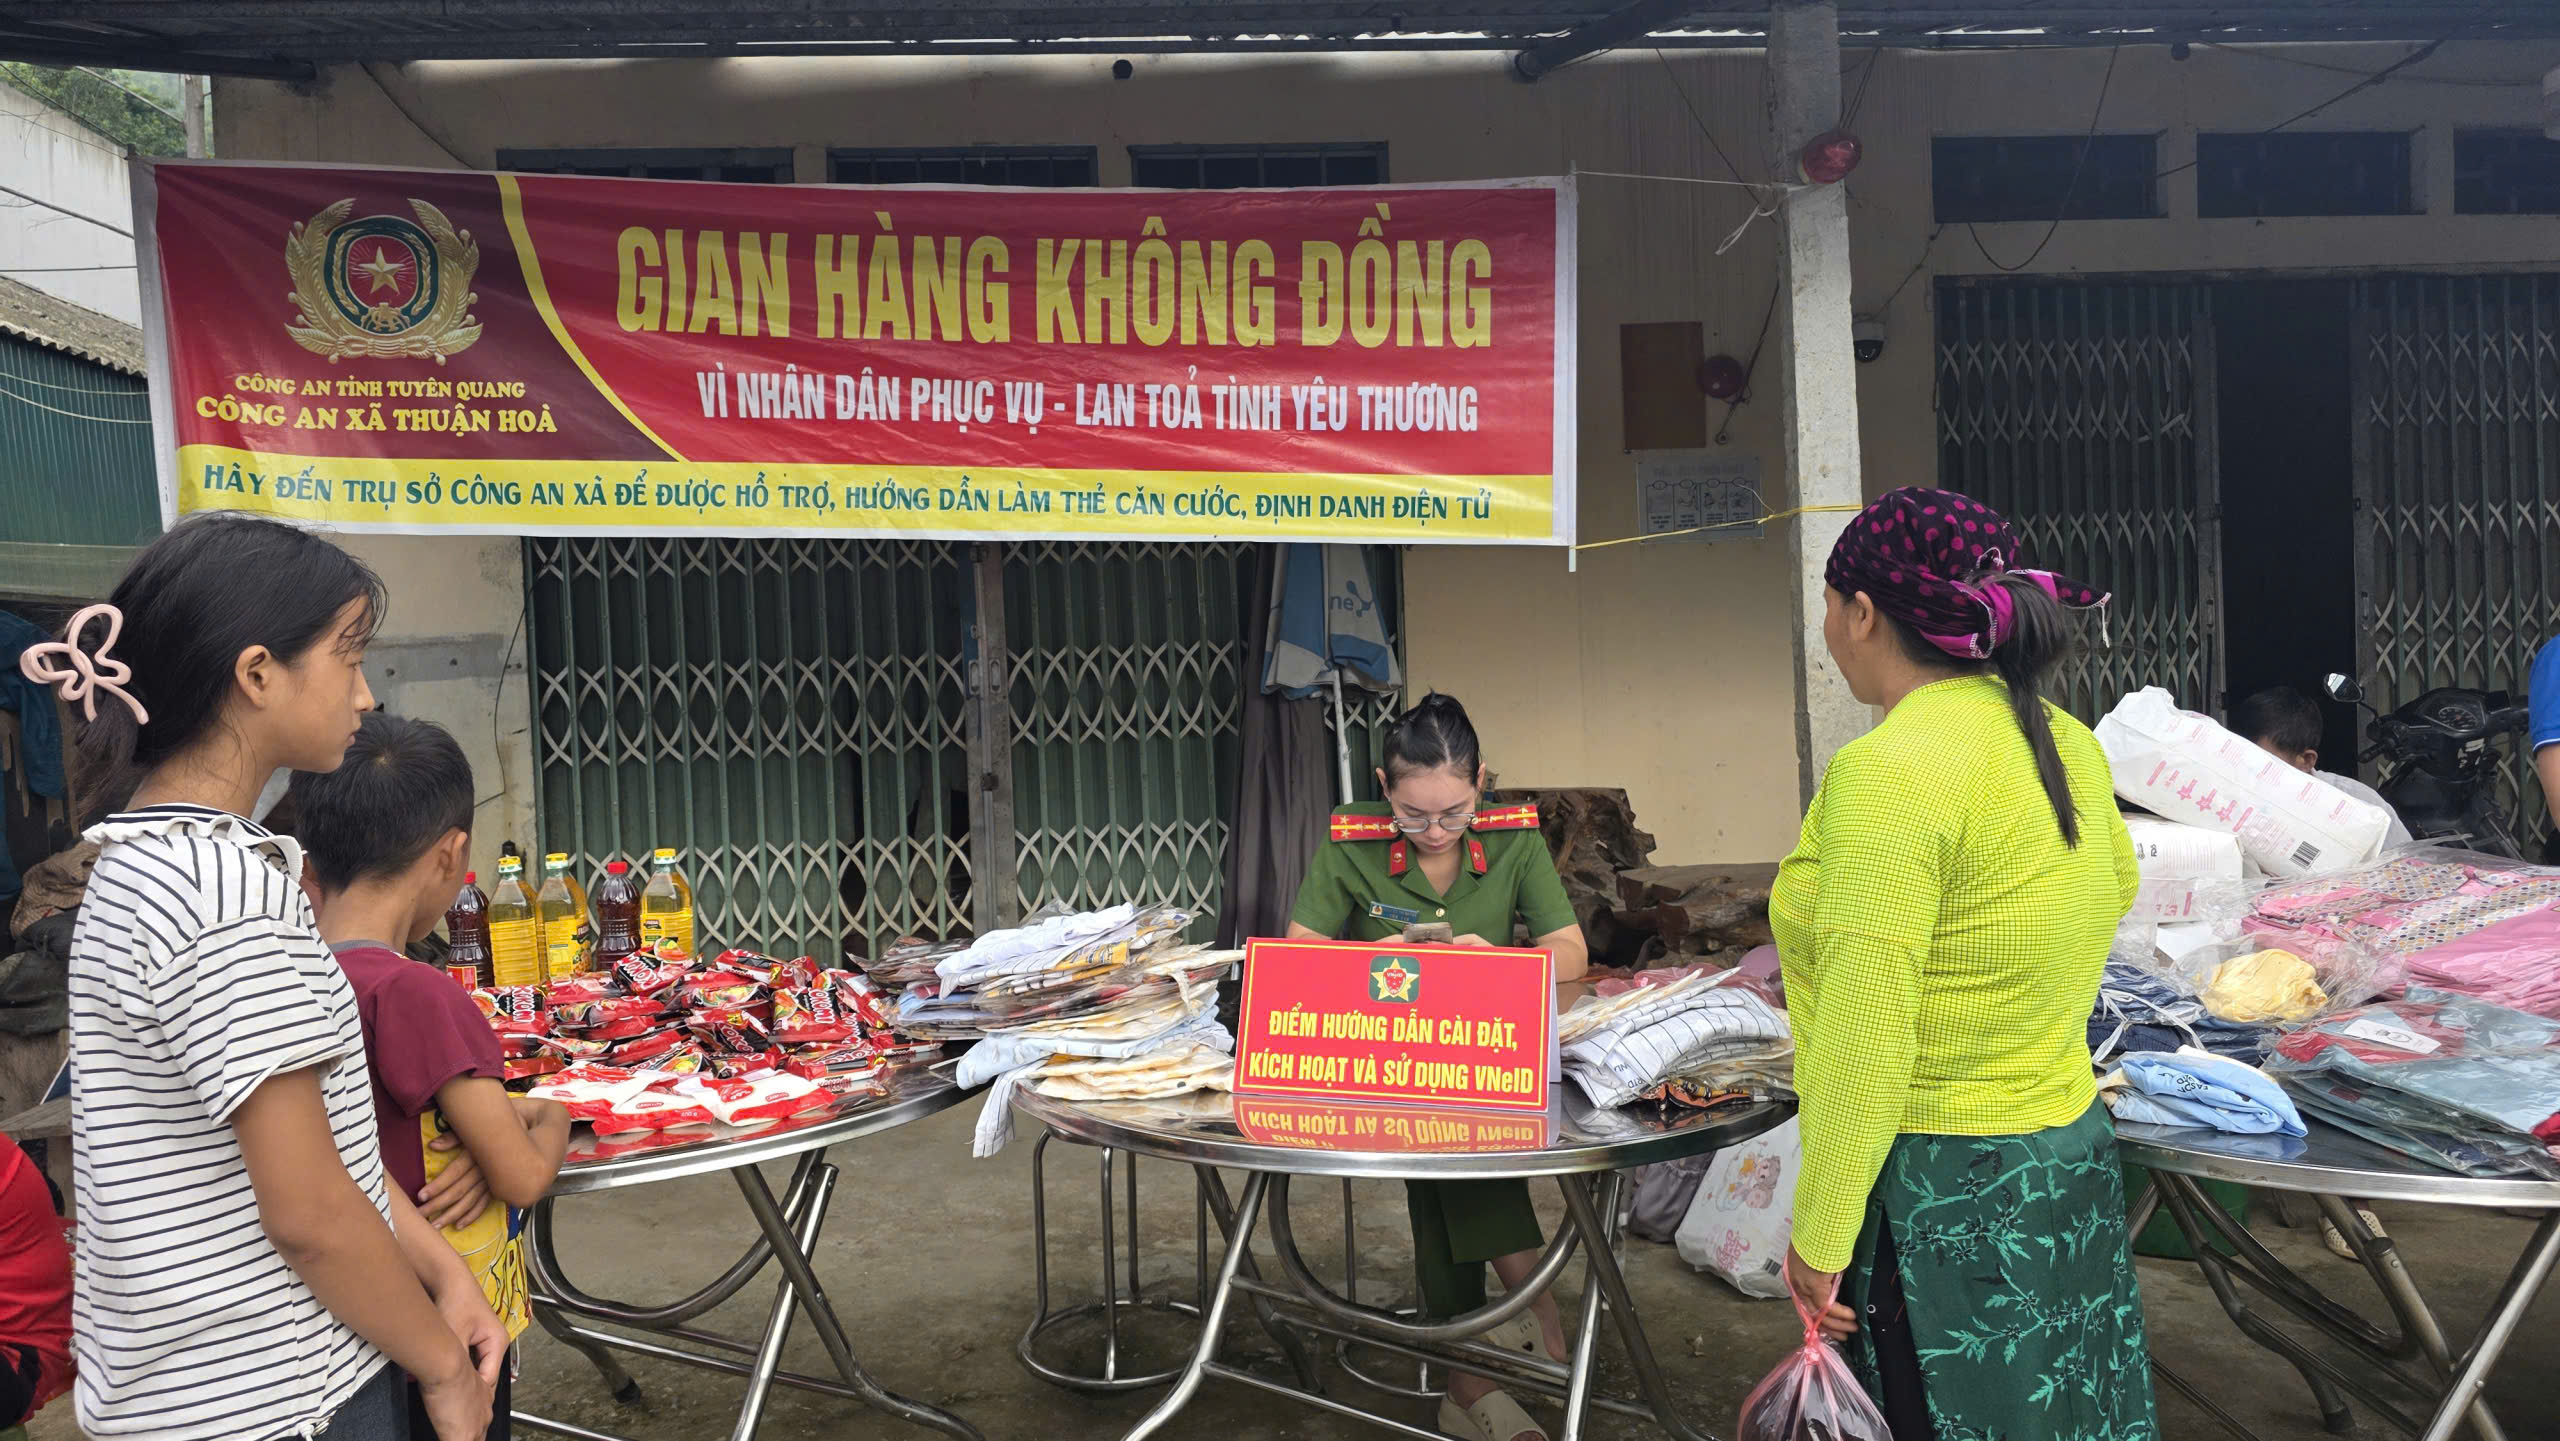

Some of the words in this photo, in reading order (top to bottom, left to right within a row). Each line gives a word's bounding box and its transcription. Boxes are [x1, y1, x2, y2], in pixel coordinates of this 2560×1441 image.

[616, 226, 791, 338] GIAN
[814, 211, 1010, 343] HÀNG
[1035, 215, 1276, 347] KHÔNG
[1298, 202, 1492, 349] ĐỒNG
[234, 373, 296, 396] CÔNG
[301, 379, 330, 397] AN
[336, 376, 382, 398] TỈNH
[387, 377, 452, 398] TUYÊN
[456, 381, 526, 400] QUANG
[696, 362, 728, 418] VÌ
[737, 364, 825, 420] NHÂN
[835, 366, 901, 421] DÂN
[910, 378, 994, 433] PHỤC
[1005, 382, 1044, 435] VỤ
[1076, 382, 1135, 428] LAN
[1144, 365, 1201, 430] TOẢ
[1212, 374, 1282, 431] TÌNH
[1291, 376, 1348, 432] YÊU
[1357, 381, 1478, 432] THƯƠNG
[196, 394, 287, 428] CÔNG
[294, 408, 339, 431] AN
[345, 404, 386, 432] XÃ
[392, 403, 491, 439] THUẬN
[497, 403, 558, 434] HOÀ
[204, 462, 267, 496] HÃY
[275, 465, 332, 502] ĐẾN
[343, 480, 397, 511] TRỤ
[405, 472, 442, 505] SỞ
[451, 476, 522, 506] CÔNG
[530, 482, 565, 506] AN
[574, 476, 608, 506] XÃ
[614, 468, 648, 507] ĐỂ
[655, 478, 727, 514] ĐƯỢC
[735, 473, 769, 508] HỖ
[780, 479, 837, 516] TRỢ,
[844, 473, 931, 511] HƯỚNG
[938, 474, 990, 513] DẪN
[997, 481, 1050, 513] LÀM
[1058, 483, 1106, 515] THẺ
[1115, 485, 1165, 517] CĂN
[1173, 484, 1248, 520] CƯỚC,
[1255, 493, 1312, 525] ĐỊNH
[1319, 495, 1385, 519] DANH
[1392, 489, 1449, 526] ĐIỆN
[1455, 489, 1493, 520] TỬ
[1269, 1002, 1316, 1037] ĐIỂM
[1322, 1009, 1387, 1041] HƯỚNG
[1393, 1008, 1433, 1044] DẪN
[1439, 1015, 1471, 1046] CÀI
[1477, 1017, 1518, 1053] ĐẶT,
[1249, 1048, 1296, 1079] KÍCH
[1299, 1056, 1348, 1087] HOẠT
[1354, 1054, 1377, 1085] VÀ
[1383, 1053, 1411, 1087] SỬ
[1414, 1062, 1468, 1094] DỤNG
[1475, 1067, 1534, 1094] VNeID
